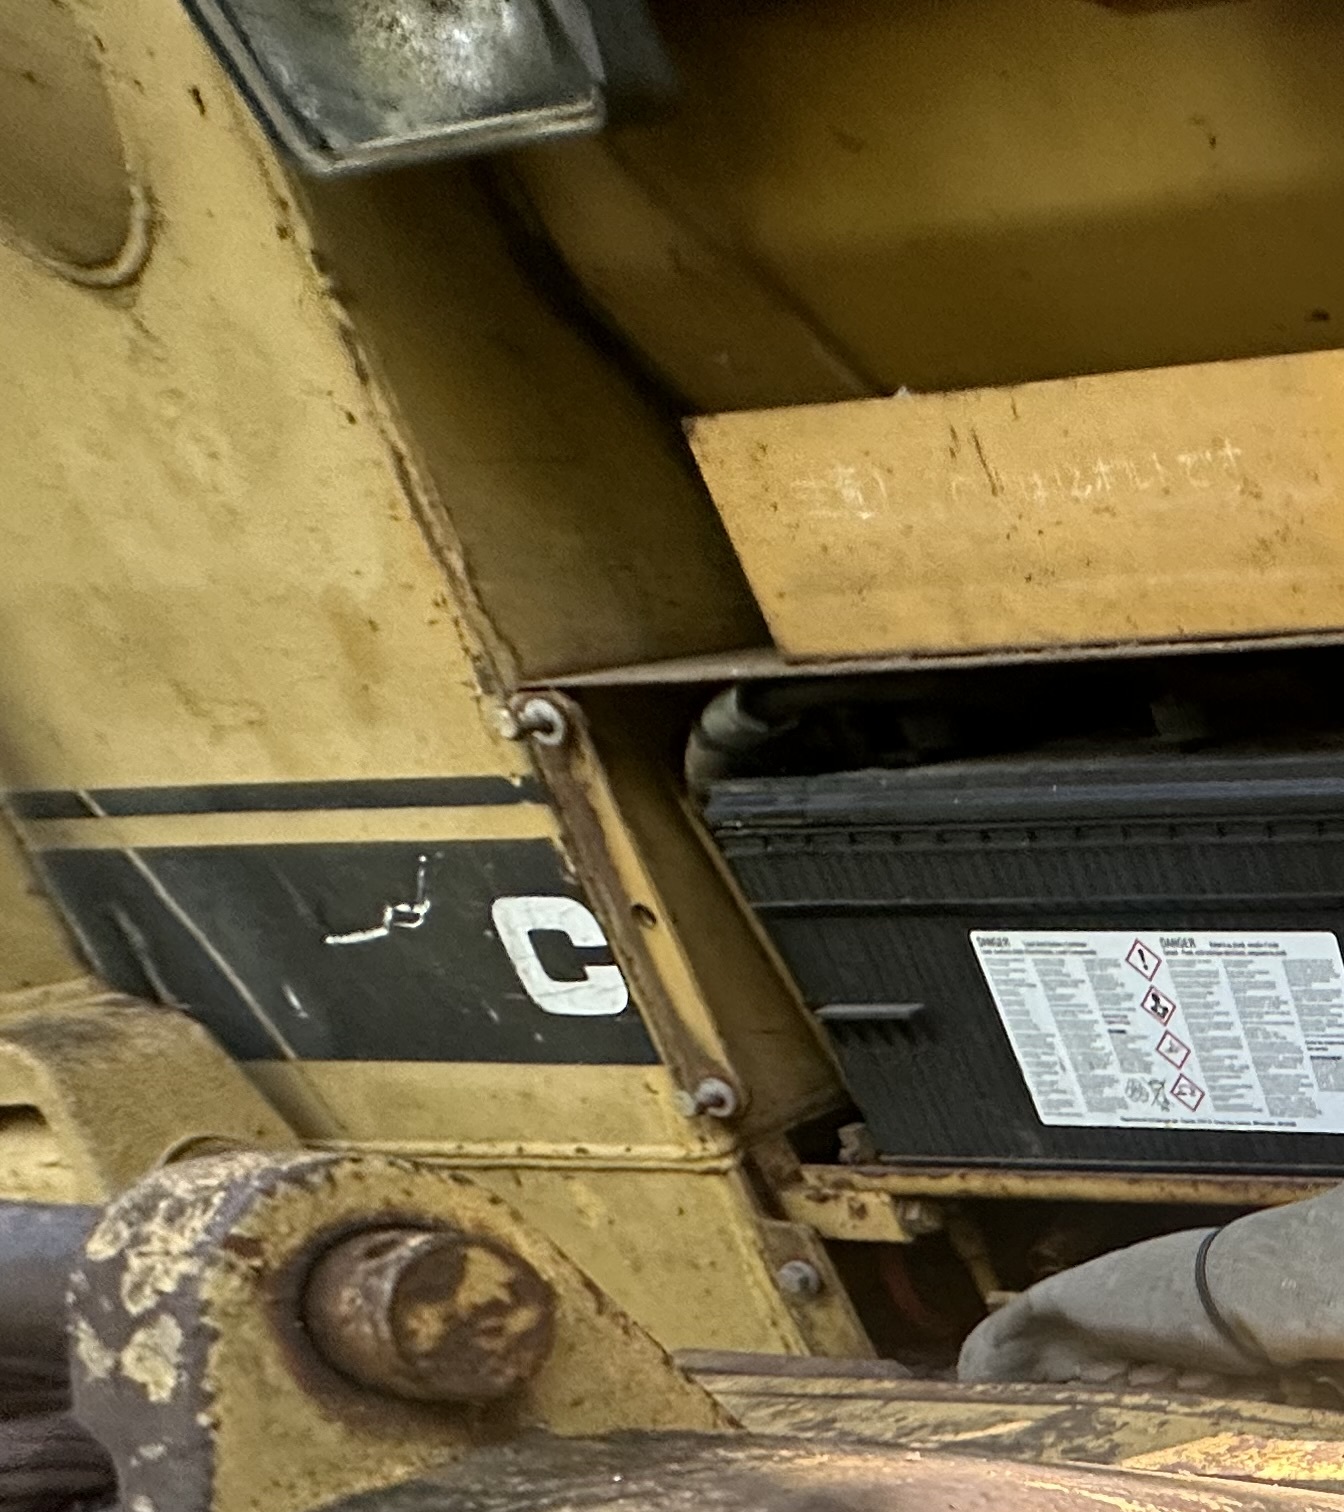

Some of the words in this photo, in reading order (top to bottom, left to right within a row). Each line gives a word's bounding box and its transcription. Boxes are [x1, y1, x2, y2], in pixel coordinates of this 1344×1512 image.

[976, 936, 1011, 948] DANGER
[1160, 936, 1196, 948] DANGER
[491, 896, 629, 1016] C
